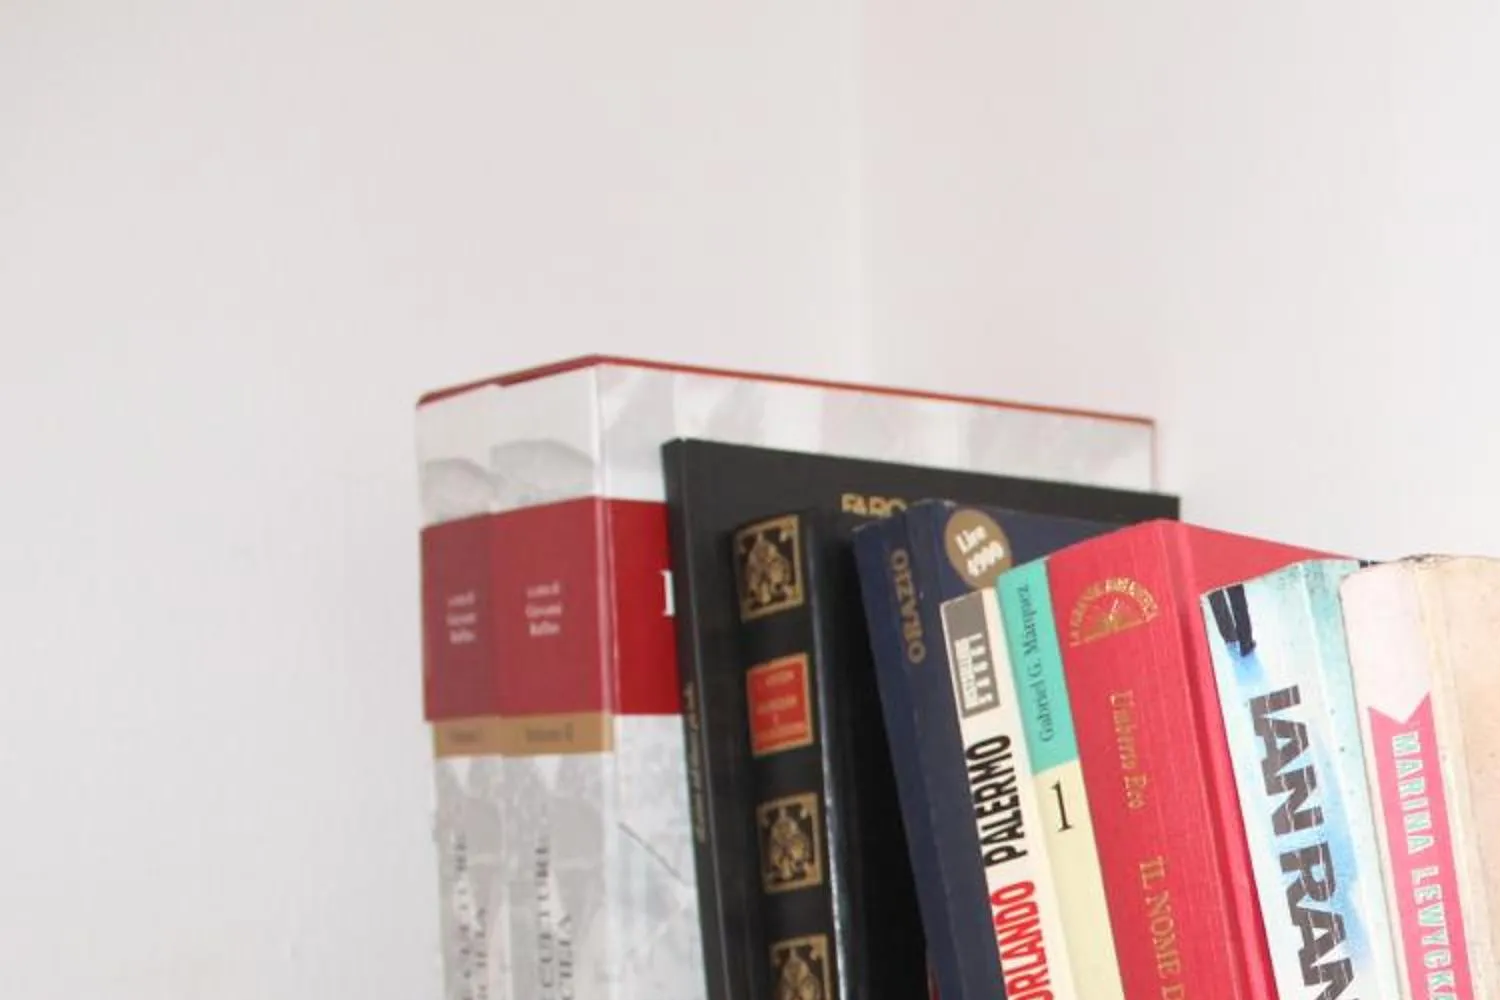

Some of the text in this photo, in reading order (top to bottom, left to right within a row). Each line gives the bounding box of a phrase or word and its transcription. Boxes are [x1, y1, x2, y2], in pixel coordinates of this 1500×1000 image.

[890, 549, 926, 664] ORAZIO
[1029, 679, 1055, 743] Gabriel
[966, 735, 1028, 868] PALERMO
[1123, 773, 1147, 810] Eco
[1249, 684, 1325, 836] IAN
[1391, 730, 1435, 856] MARINA
[1050, 780, 1073, 834] 1
[1139, 856, 1166, 890] IL
[1145, 891, 1184, 980] NOME
